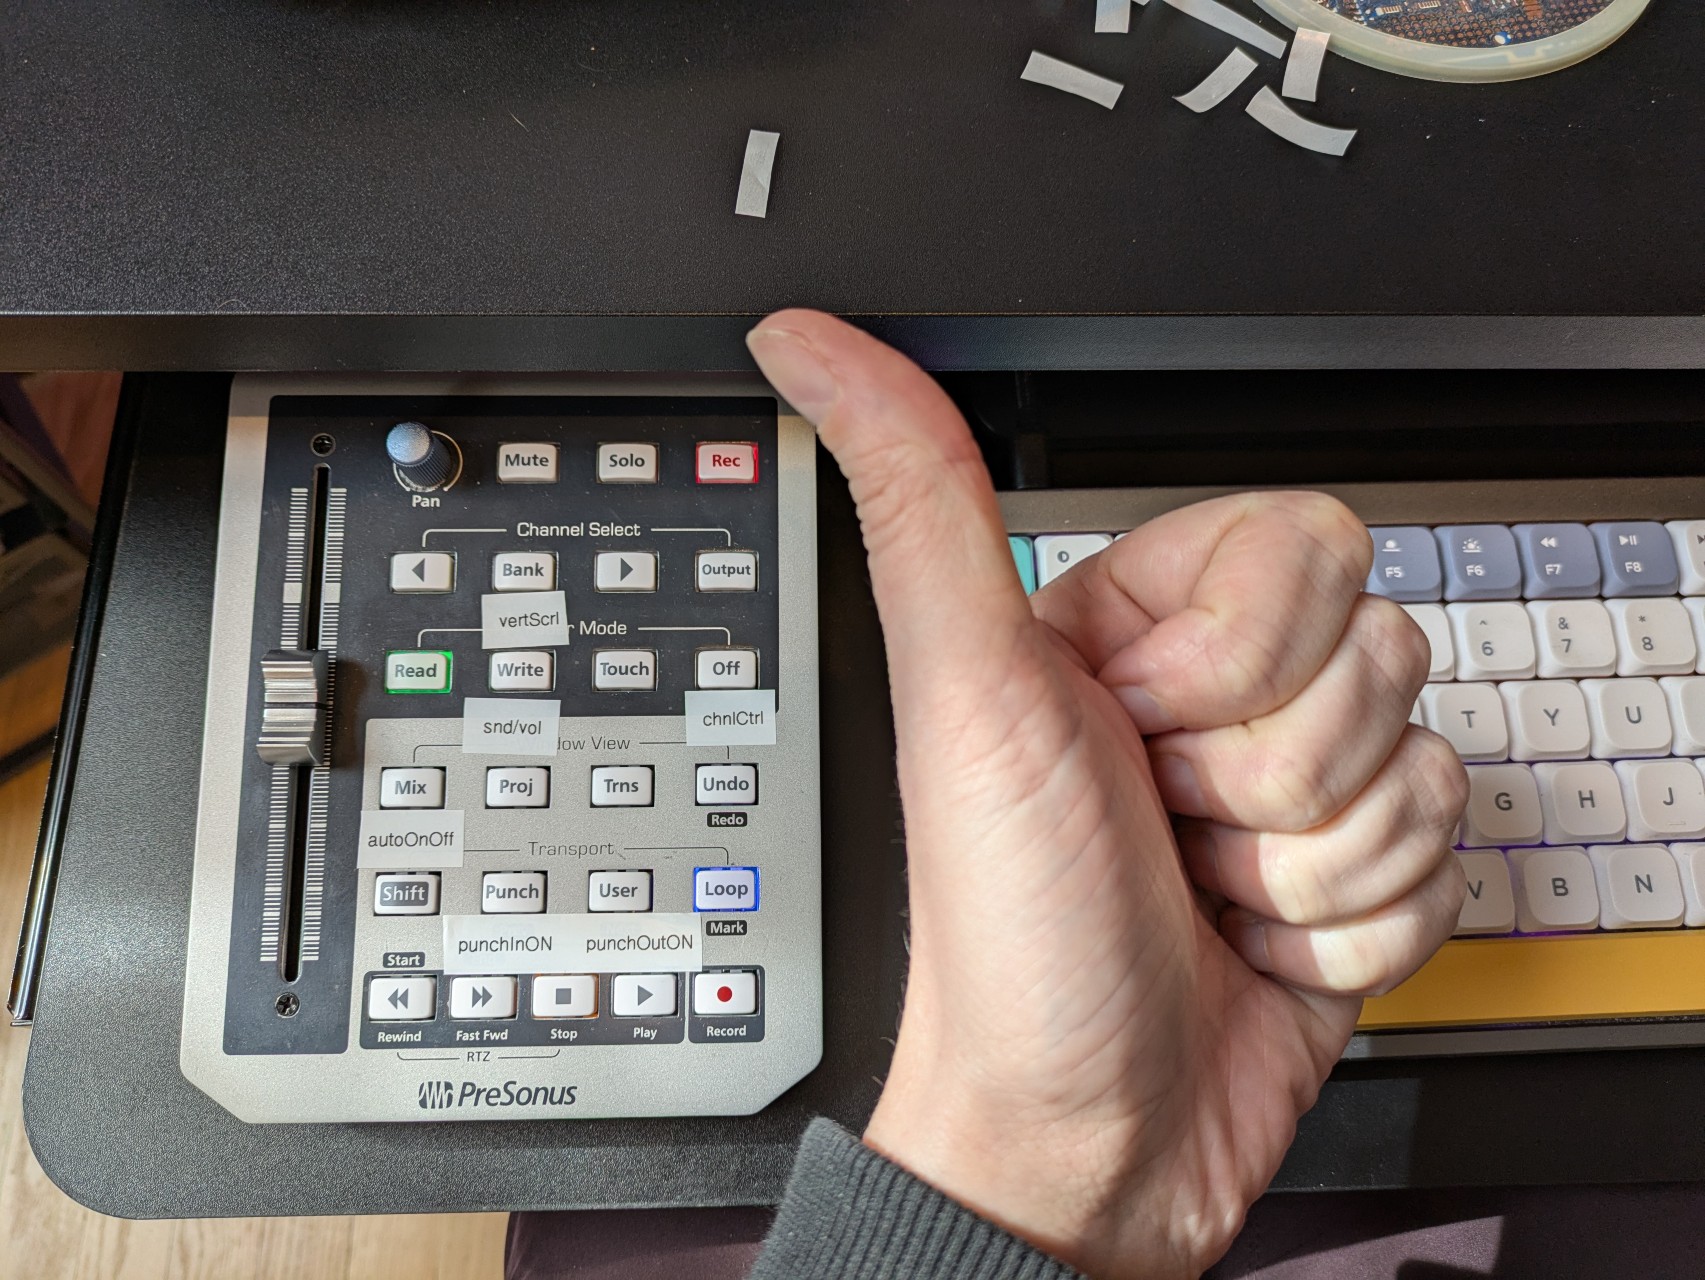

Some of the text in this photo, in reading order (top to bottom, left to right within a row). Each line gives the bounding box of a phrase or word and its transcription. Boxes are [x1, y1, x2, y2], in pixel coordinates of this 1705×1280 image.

[504, 452, 550, 469] Mute
[608, 452, 646, 469] Solo
[711, 453, 741, 469] Rec
[411, 495, 441, 510] Pan
[516, 521, 641, 538] Channel Select
[502, 562, 545, 578] Bank
[701, 562, 752, 579] Output
[1385, 567, 1403, 579] F5
[1466, 565, 1484, 577] F6
[1545, 564, 1562, 576] F7
[1625, 561, 1642, 573] F8
[499, 612, 560, 628] vertScrl
[579, 620, 628, 636] Mode
[1481, 641, 1494, 657] 6
[1561, 639, 1572, 654] 7
[1641, 636, 1655, 651] 8
[394, 662, 439, 679] Read
[496, 662, 545, 679] Write
[599, 661, 650, 678] Touch
[712, 660, 741, 677] Off
[702, 710, 764, 727] chnlCtrl
[1460, 709, 1476, 729] T
[1543, 708, 1560, 727] Y
[1625, 705, 1642, 725] U
[483, 719, 542, 735] snd/vol
[591, 736, 631, 751] View
[394, 780, 427, 795] Mix
[499, 778, 534, 797] Proj
[604, 778, 639, 794] Trns
[702, 776, 750, 792] Undo
[1494, 792, 1513, 811] G
[1577, 789, 1596, 809] H
[1662, 787, 1675, 806] J
[711, 814, 745, 826] Redo
[367, 831, 455, 847] autoOnOff
[528, 841, 615, 859] Transport
[485, 883, 540, 899] Punch
[599, 882, 638, 899] User
[704, 881, 749, 900] Loop
[1467, 880, 1483, 900] V
[1551, 877, 1569, 897] B
[1634, 874, 1653, 894] N
[382, 884, 426, 902] Shift
[710, 922, 744, 934] Mark
[458, 934, 693, 955] punchInON punchOutON
[387, 953, 421, 967] Start
[377, 1029, 422, 1043] Rewind
[456, 1028, 509, 1041] Fast Fwd
[550, 1027, 578, 1042] Stop
[633, 1026, 658, 1041] Play
[706, 1024, 747, 1037] Record
[466, 1051, 491, 1063] RTZ
[457, 1080, 578, 1107] PreSonus
